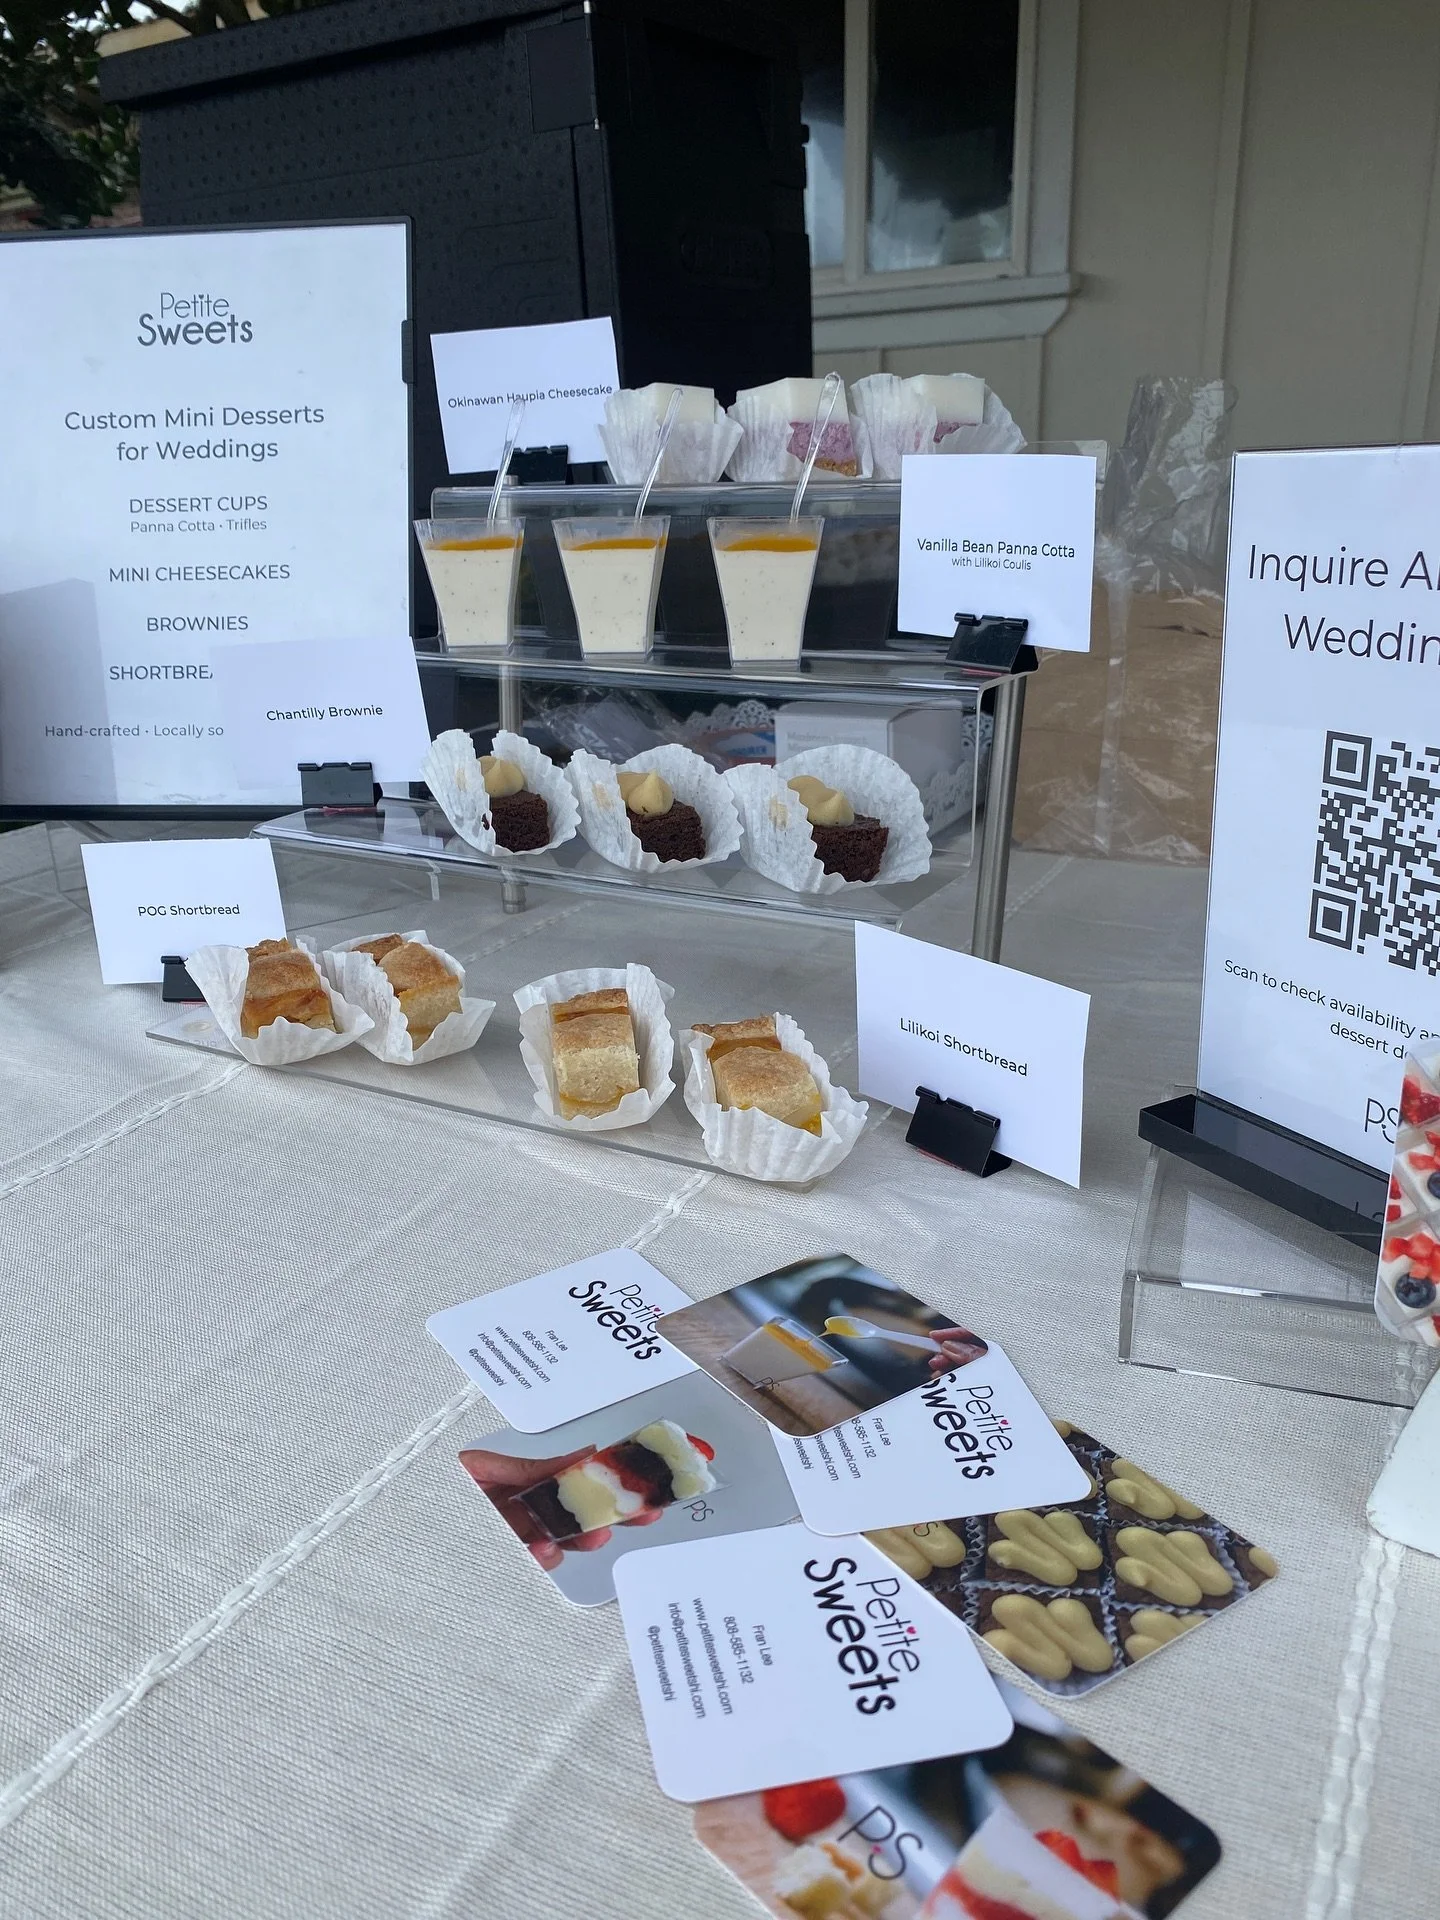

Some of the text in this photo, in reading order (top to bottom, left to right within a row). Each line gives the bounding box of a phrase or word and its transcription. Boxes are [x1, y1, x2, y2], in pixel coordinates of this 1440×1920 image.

[160, 292, 230, 320] Petite
[137, 313, 254, 347] Sweets
[447, 384, 613, 409] Okinawan Haupia Cheesecake
[64, 405, 325, 431] Custom Mini Desserts
[116, 438, 279, 463] for Weddings
[129, 495, 268, 514] DESSERT CUPS
[130, 517, 267, 533] Panna Cotta Trifles
[917, 538, 1075, 558] Vanilla Bean Panna Cotta
[109, 564, 291, 583] MINI CHEESECAKES
[951, 556, 1032, 571] with Lilikoi Coulis
[1249, 544, 1440, 592] Inquire A
[147, 615, 249, 632] BROWNIES
[109, 664, 213, 681] SHORTBRE
[266, 704, 383, 721] Chantilly Brownie
[45, 723, 224, 739] Hand-crafted Locally so
[137, 903, 240, 917] POG Shortbread
[1224, 959, 1258, 983] Scan
[1262, 972, 1277, 988] to
[1280, 980, 1326, 1006] check
[1329, 998, 1416, 1039] availability
[900, 1017, 1028, 1077] Lilikoi Shortbread
[1330, 1021, 1408, 1060] dessert d
[567, 1280, 662, 1361] Sweets
[545, 1329, 569, 1352] Fran Lee
[468, 1348, 507, 1387] @petitesweetshi
[871, 1416, 891, 1447] Fran Lee
[955, 1385, 1014, 1452] Petite
[682, 1499, 715, 1522] PS
[912, 1521, 939, 1538] S
[803, 1556, 899, 1715] Sweets
[855, 1576, 921, 1673] Petite
[693, 1597, 734, 1716] www.petitesweetshi.com
[723, 1616, 755, 1684] 808-585-1132
[752, 1624, 774, 1667] Fran Lee
[647, 1625, 678, 1702] @petitesweetshi
[838, 1803, 923, 1881] PS
